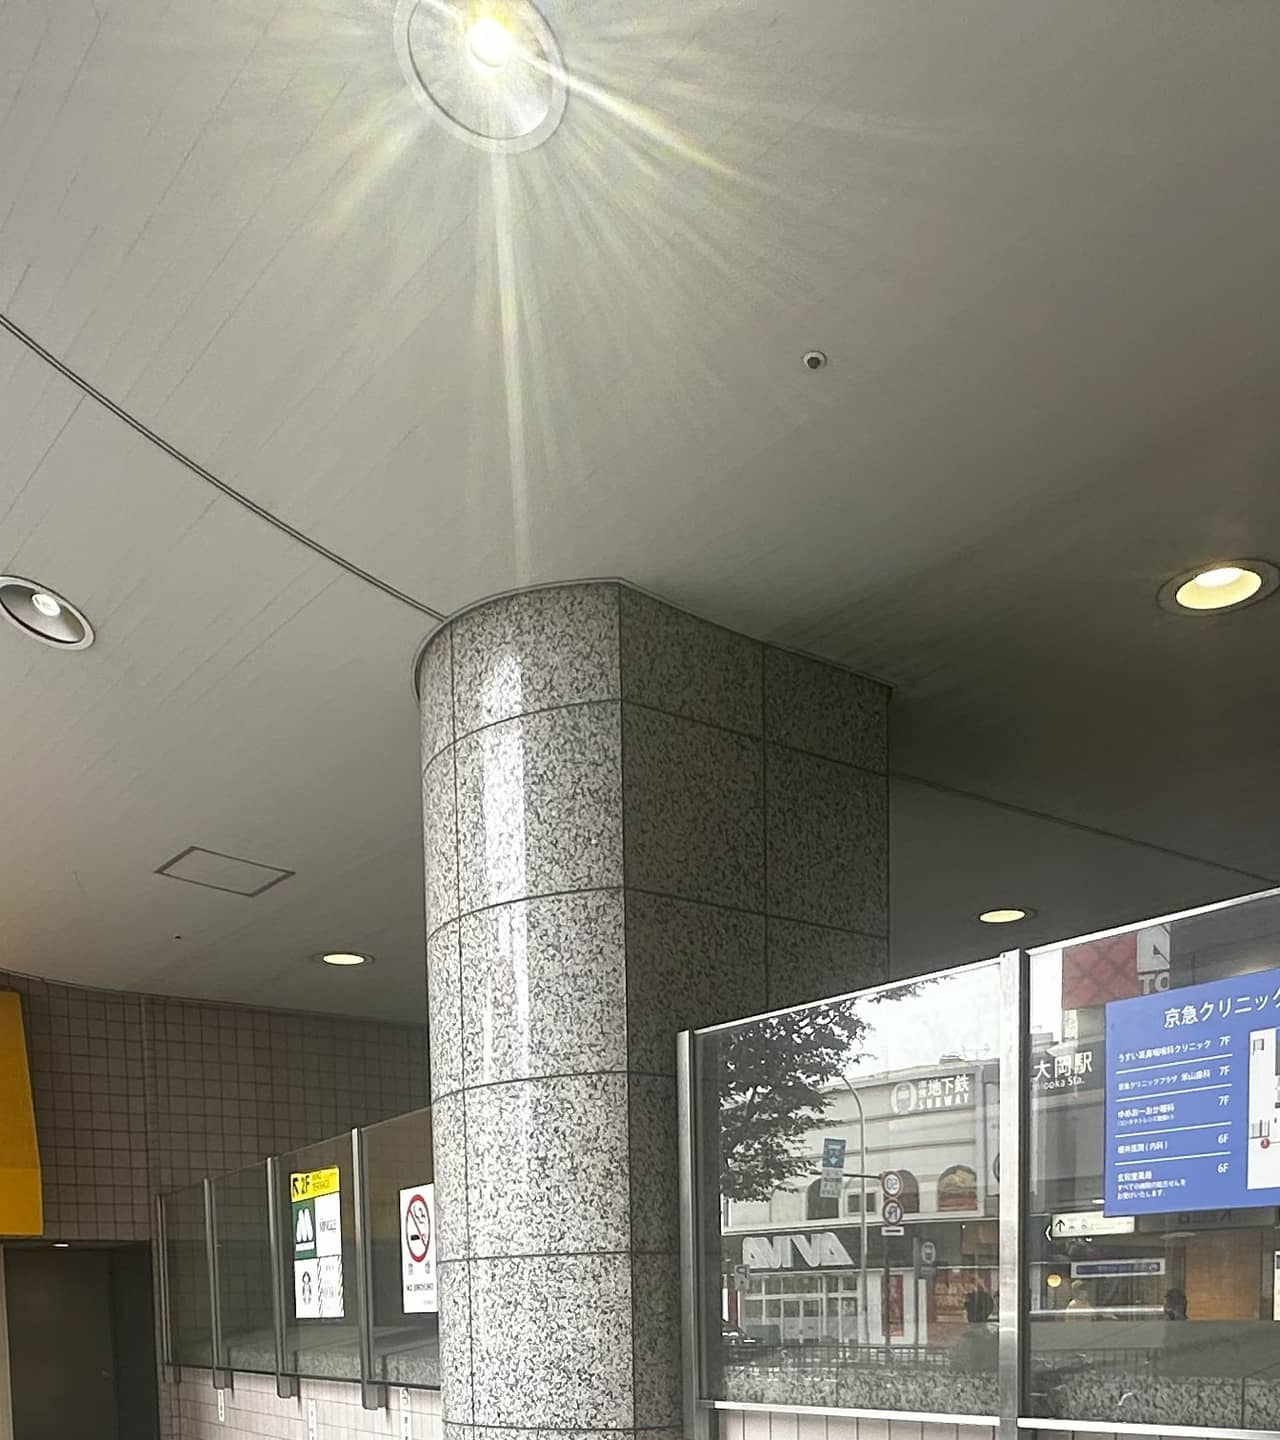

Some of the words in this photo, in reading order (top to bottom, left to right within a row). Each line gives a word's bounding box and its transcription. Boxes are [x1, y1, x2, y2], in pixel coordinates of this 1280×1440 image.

[1219, 1035, 1231, 1048] 7F
[1218, 1065, 1230, 1077] 7F
[1218, 1095, 1230, 1106] 7F
[1217, 1133, 1229, 1145] 6F
[1217, 1162, 1229, 1174] 6F
